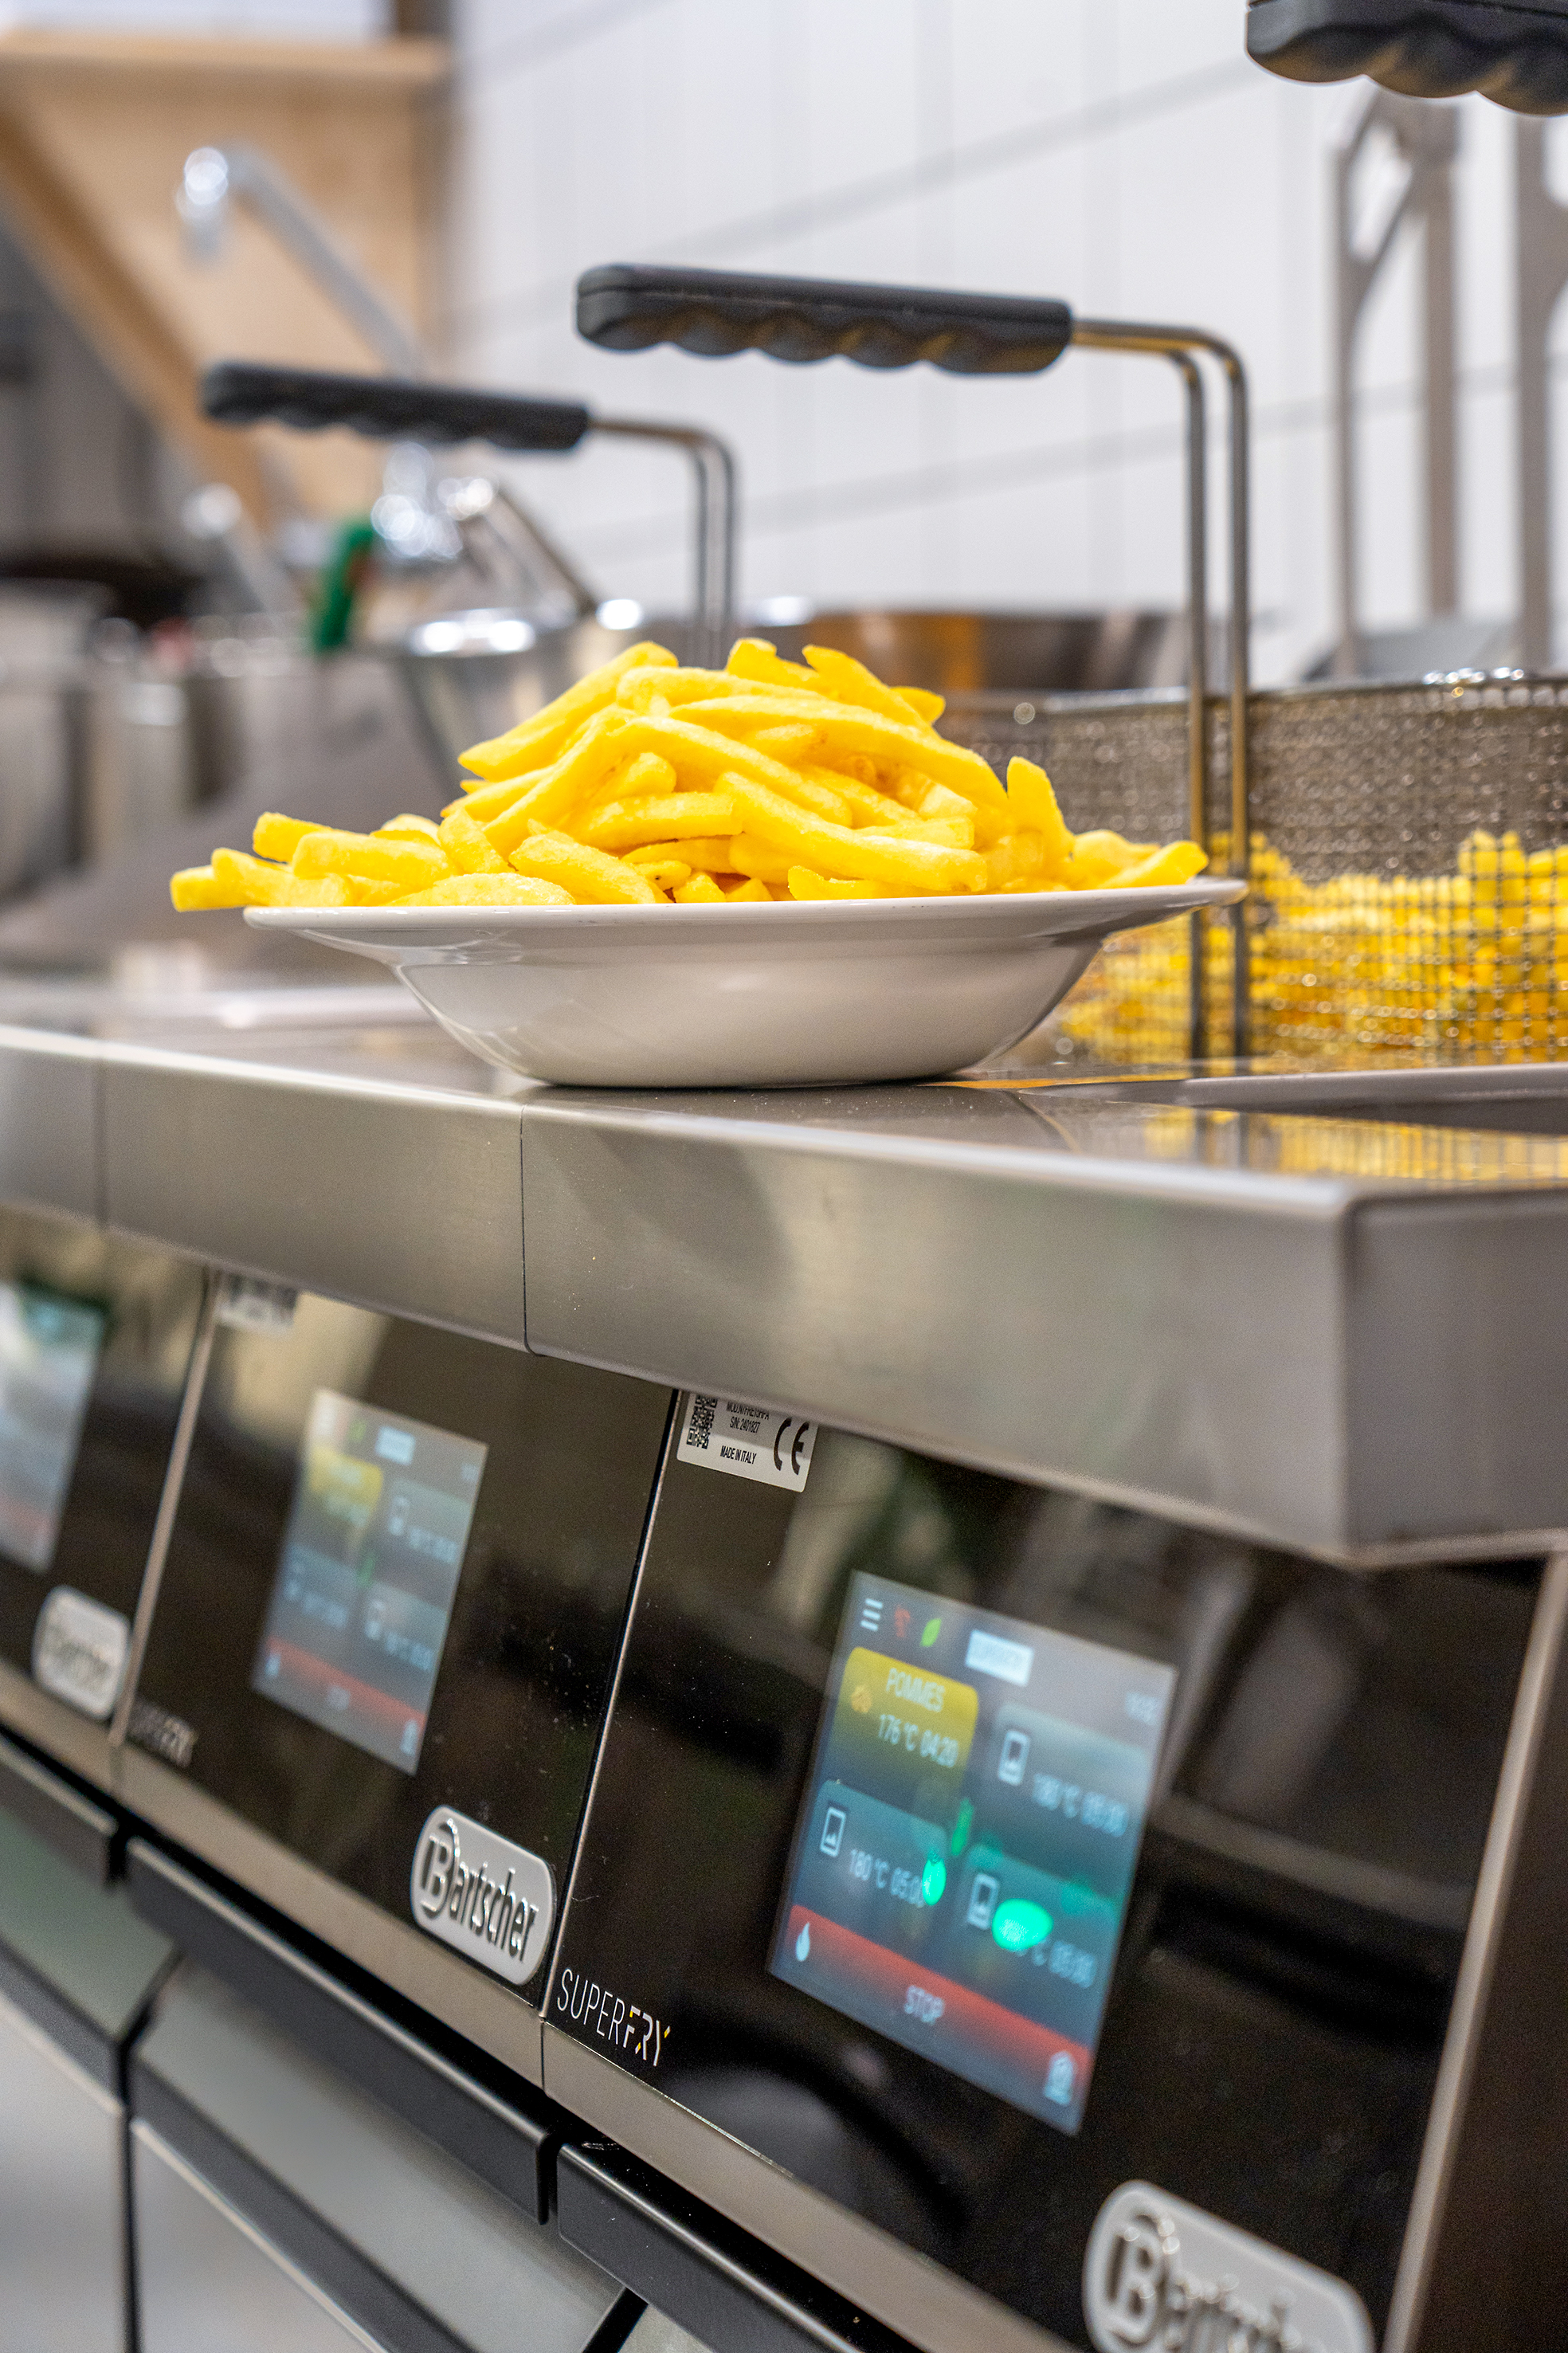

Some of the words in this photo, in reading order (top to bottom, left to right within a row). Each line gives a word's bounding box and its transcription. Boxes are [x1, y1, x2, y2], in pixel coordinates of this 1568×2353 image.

[720, 1445, 735, 1460] MADE
[735, 1449, 742, 1461] IN
[741, 1450, 757, 1465] ITALY
[886, 1668, 946, 1712] POMMES
[422, 1818, 539, 1962] Bartscher
[558, 1968, 671, 2067] SUPERFRY
[904, 1985, 946, 2025] STOP
